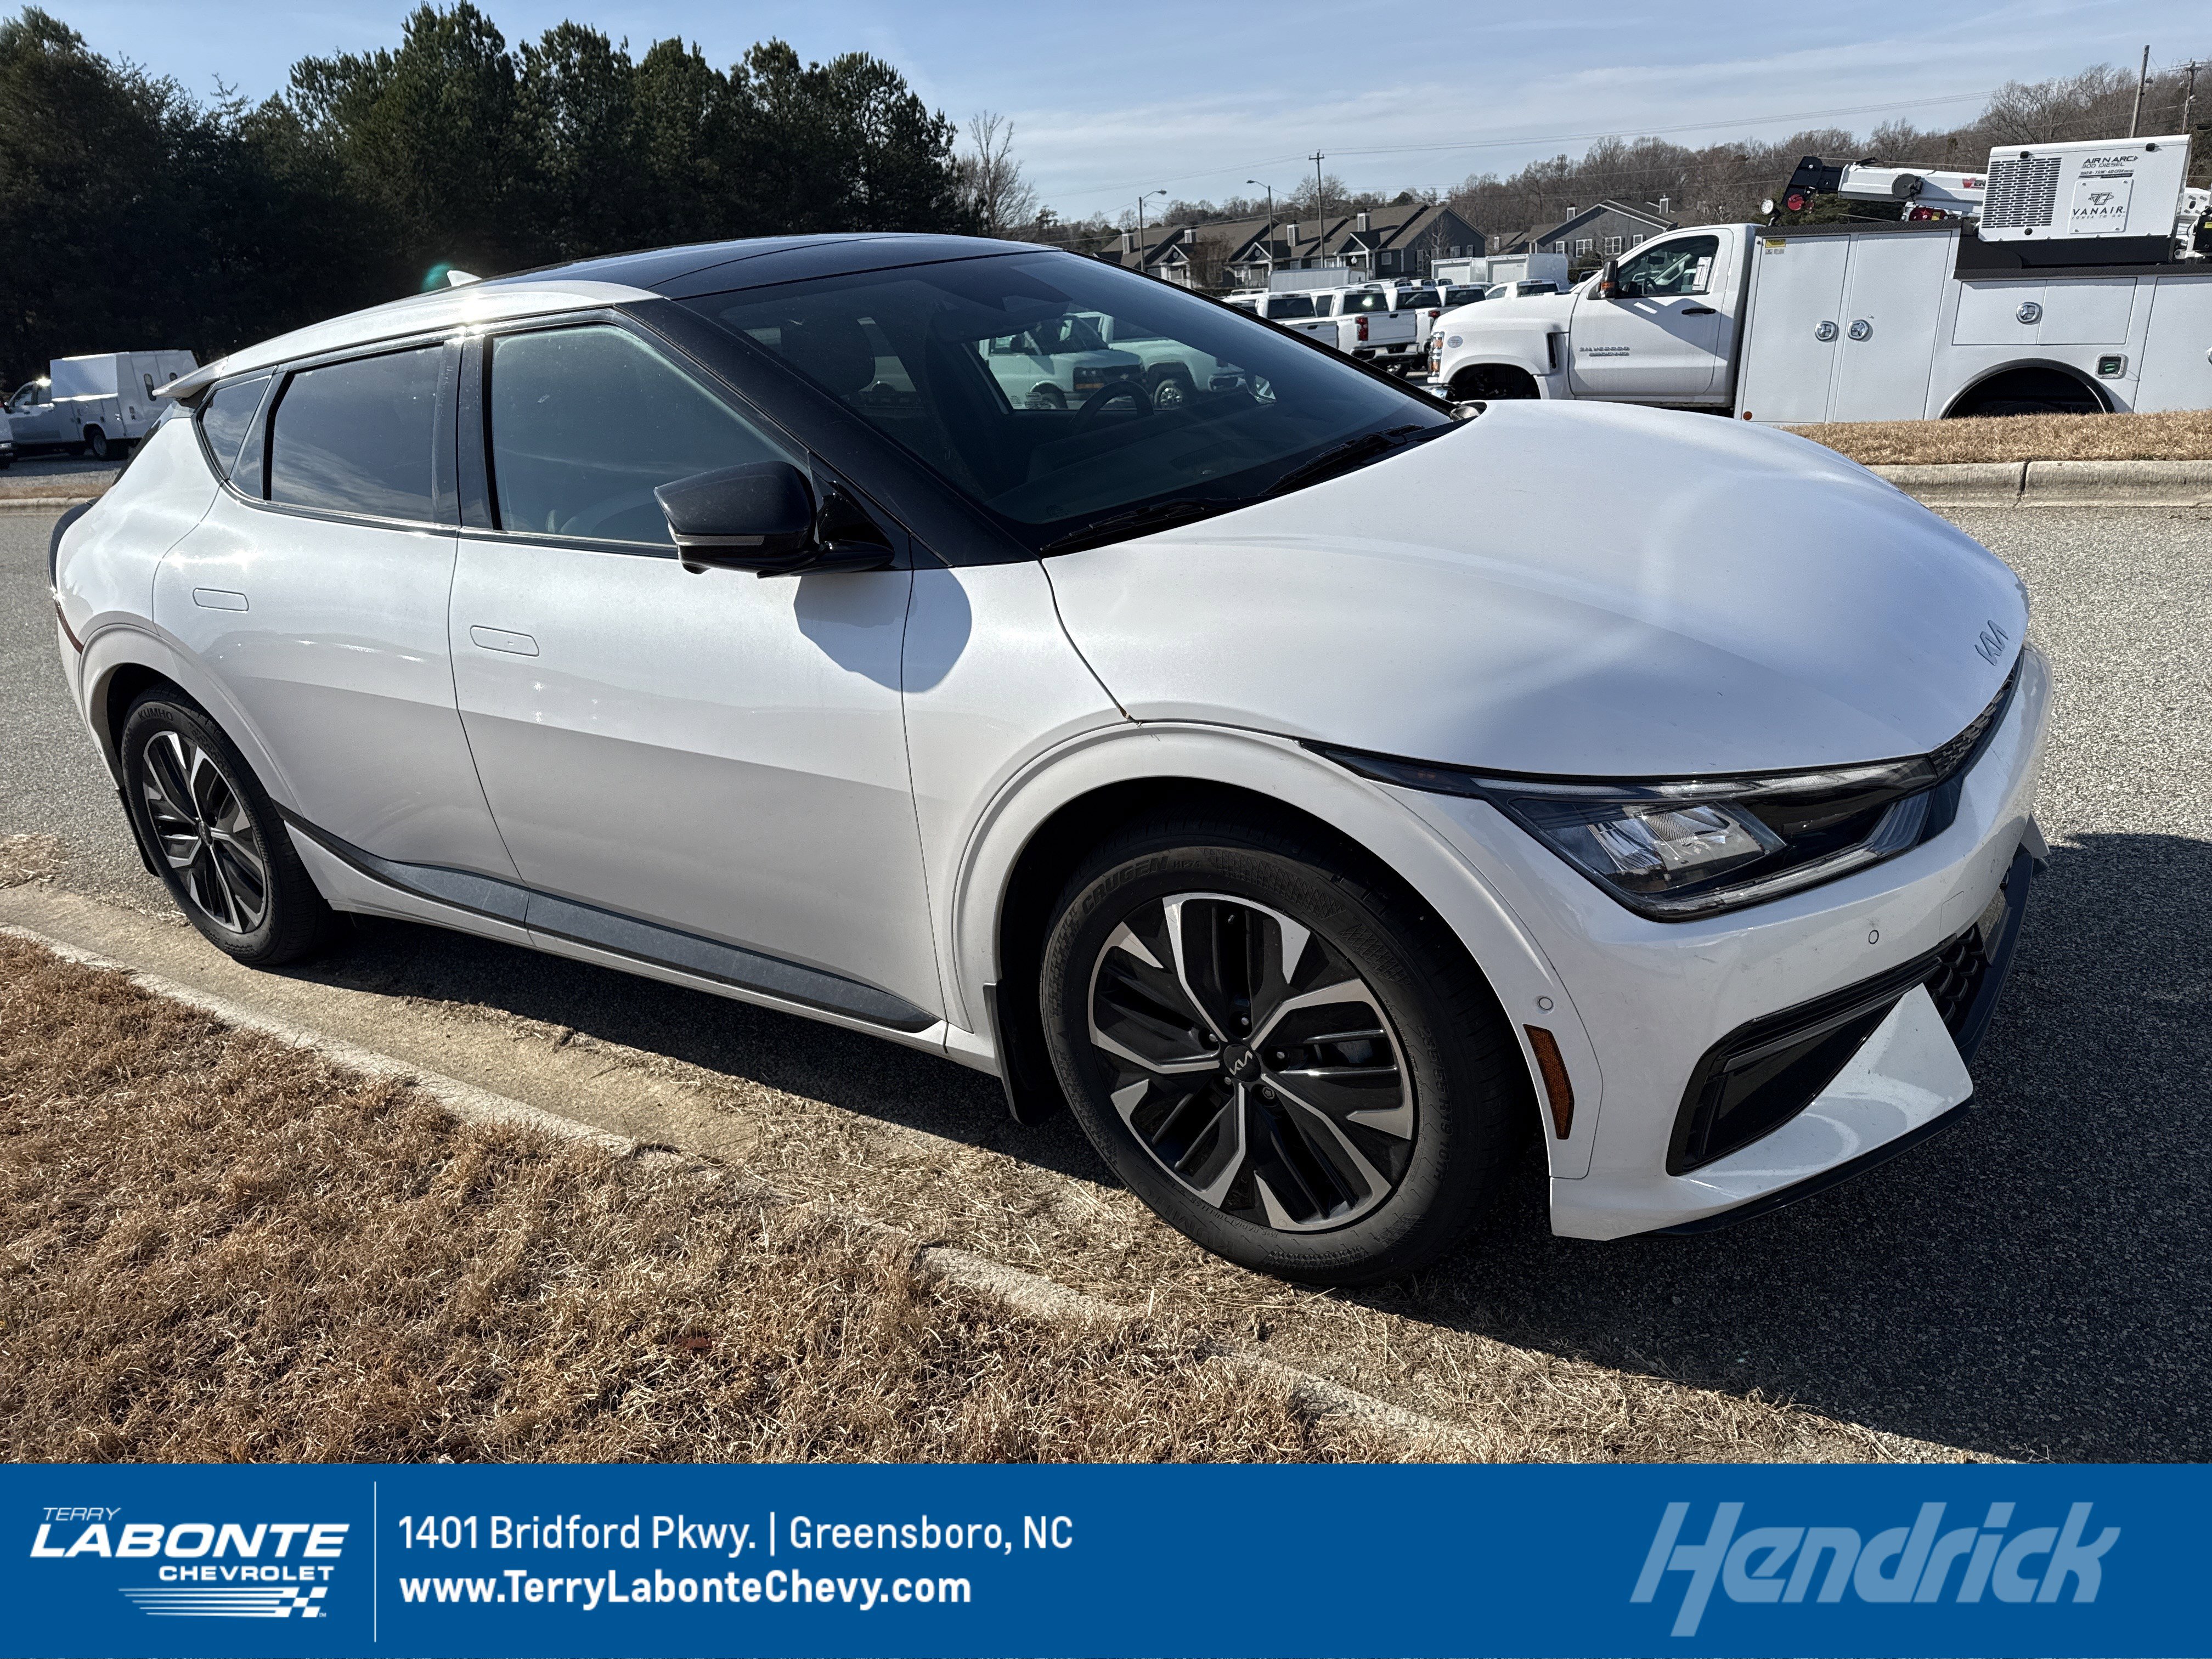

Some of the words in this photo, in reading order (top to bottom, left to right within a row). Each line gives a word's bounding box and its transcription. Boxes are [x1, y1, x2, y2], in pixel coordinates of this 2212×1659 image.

[2073, 206, 2123, 216] VANAIR
[1974, 619, 2009, 666] KIA
[138, 708, 174, 721] KUMHO
[1082, 855, 1170, 916] CRUGEN
[1229, 1050, 1254, 1076] KIA
[1417, 1025, 1450, 1095] 235/55
[1438, 1097, 1453, 1136] R19
